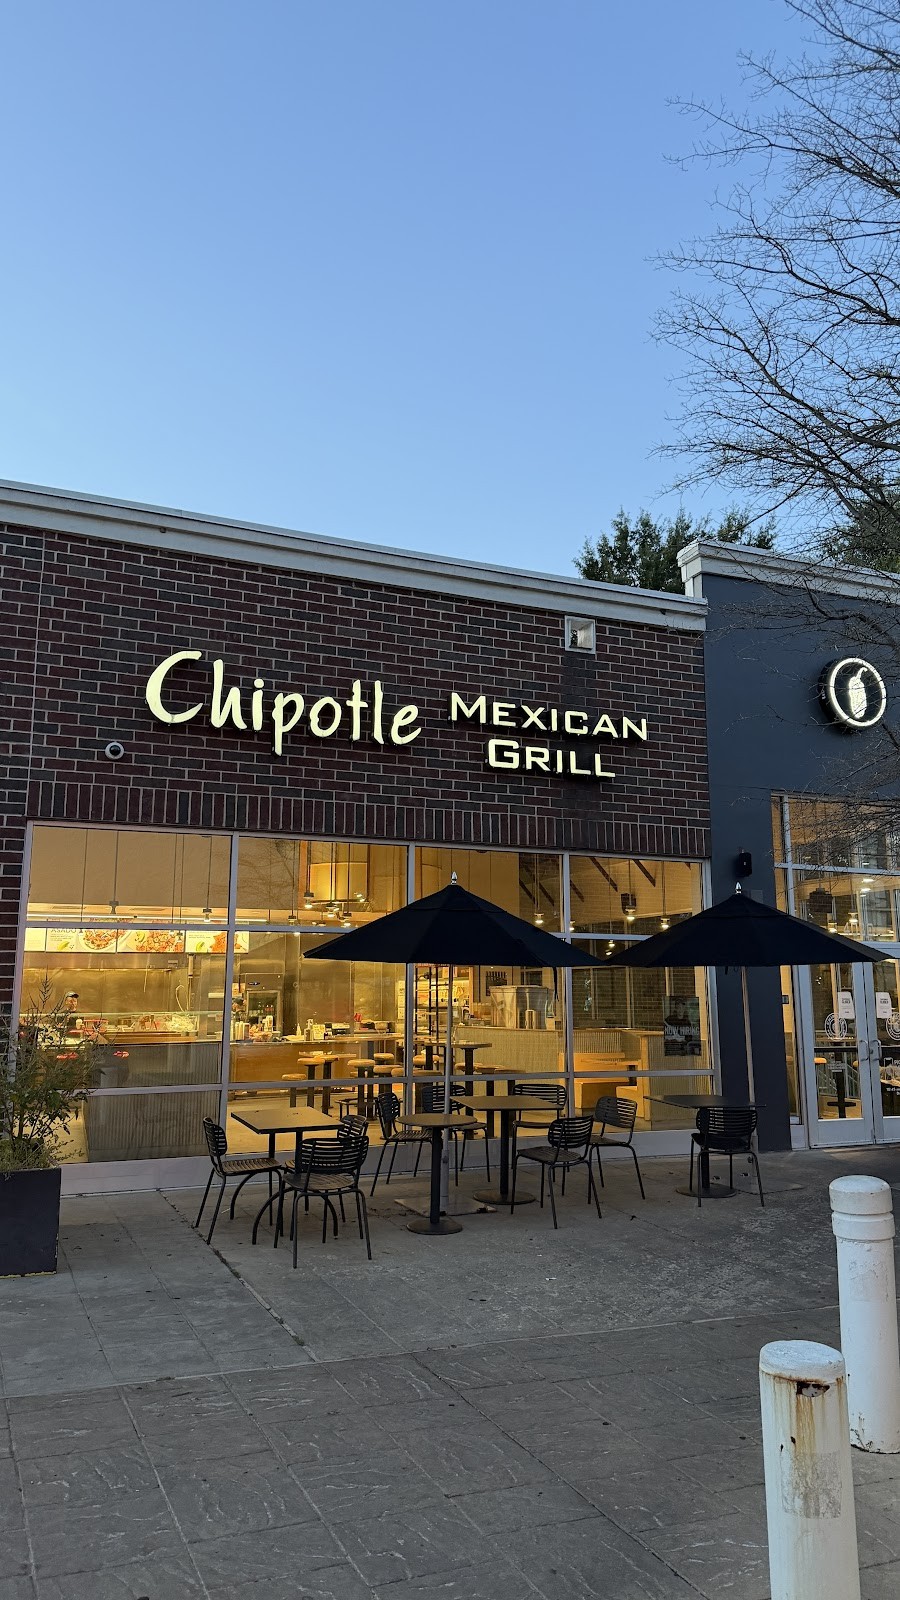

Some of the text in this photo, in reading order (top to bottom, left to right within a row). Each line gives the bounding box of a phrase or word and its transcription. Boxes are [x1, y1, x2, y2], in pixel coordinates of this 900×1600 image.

[145, 650, 422, 756] Chipotle
[451, 692, 648, 741] MEXICAN
[488, 738, 616, 778] GRILL
